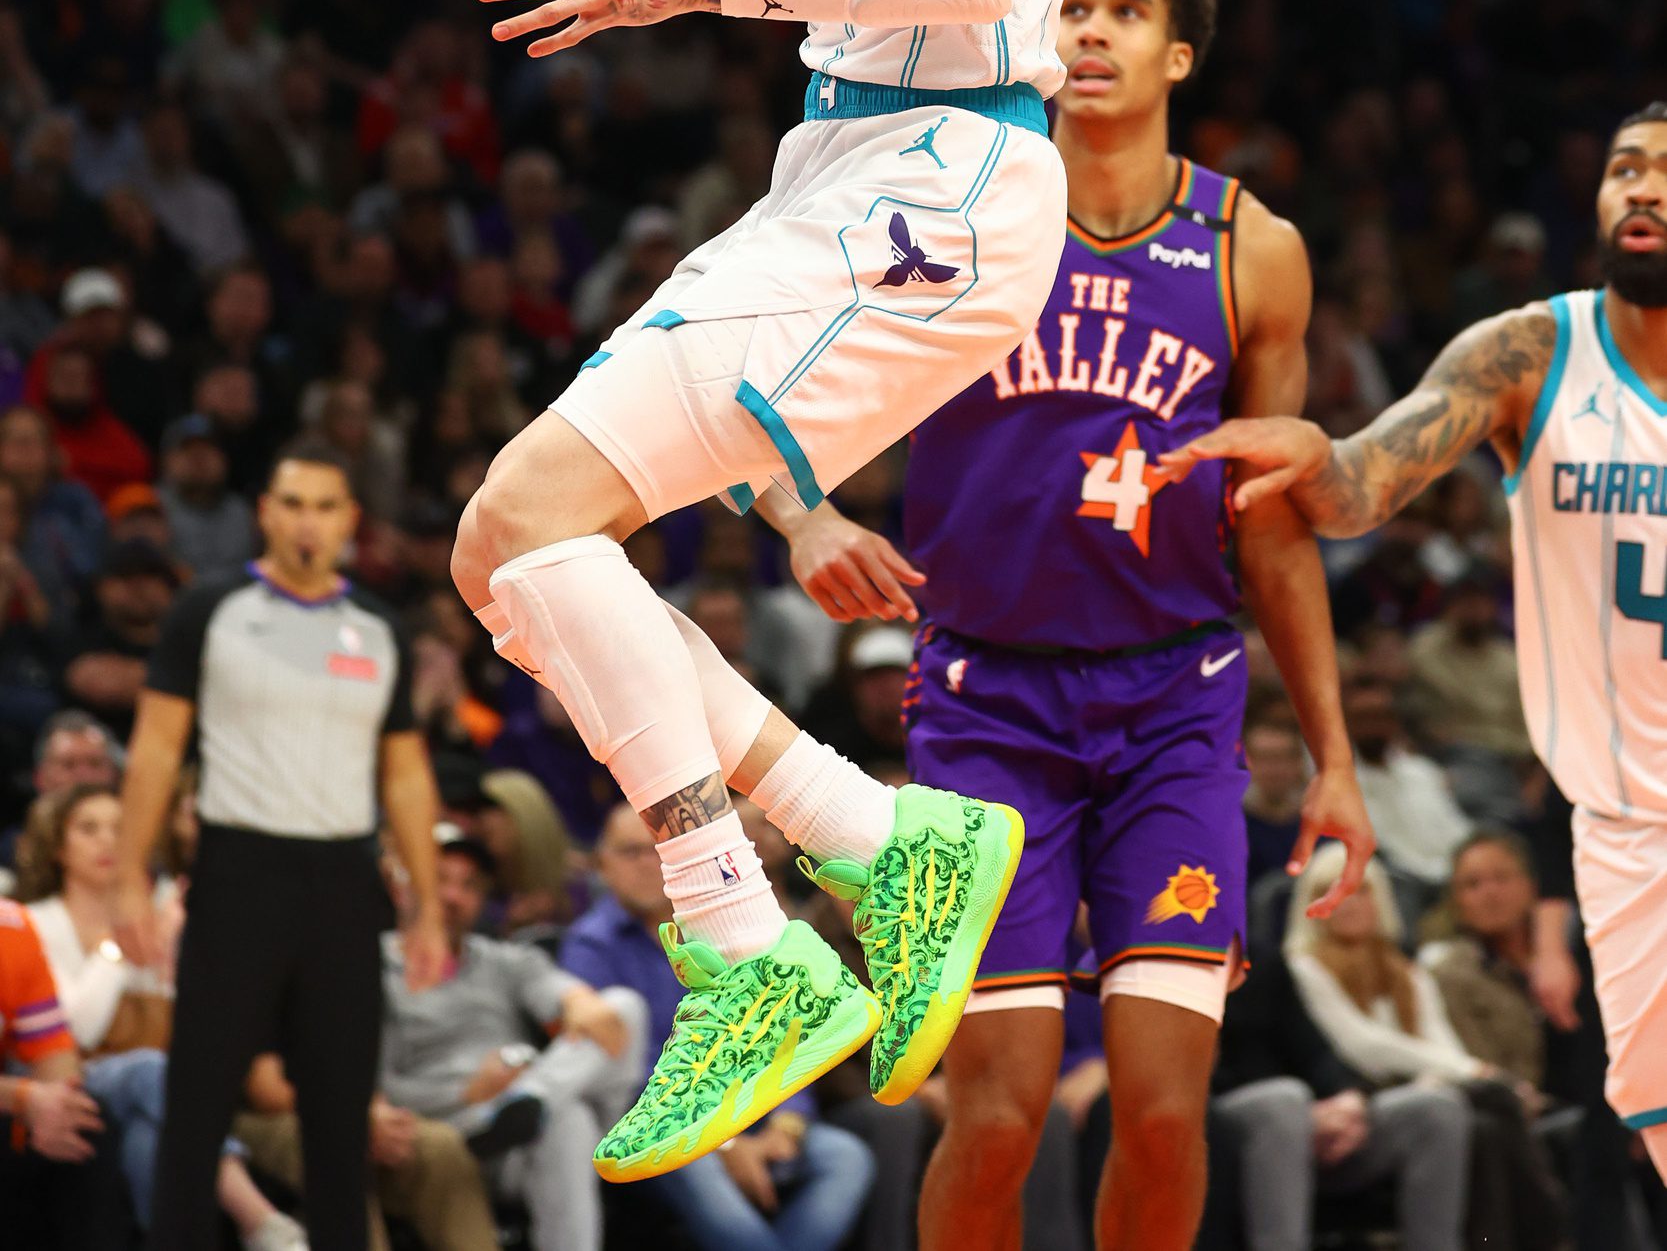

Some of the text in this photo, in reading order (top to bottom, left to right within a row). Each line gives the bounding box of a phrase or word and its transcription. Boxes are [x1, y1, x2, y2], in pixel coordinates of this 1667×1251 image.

[1148, 242, 1211, 269] PayPal
[1069, 272, 1131, 314] THE
[1081, 449, 1150, 531] 4
[1615, 540, 1667, 661] 4
